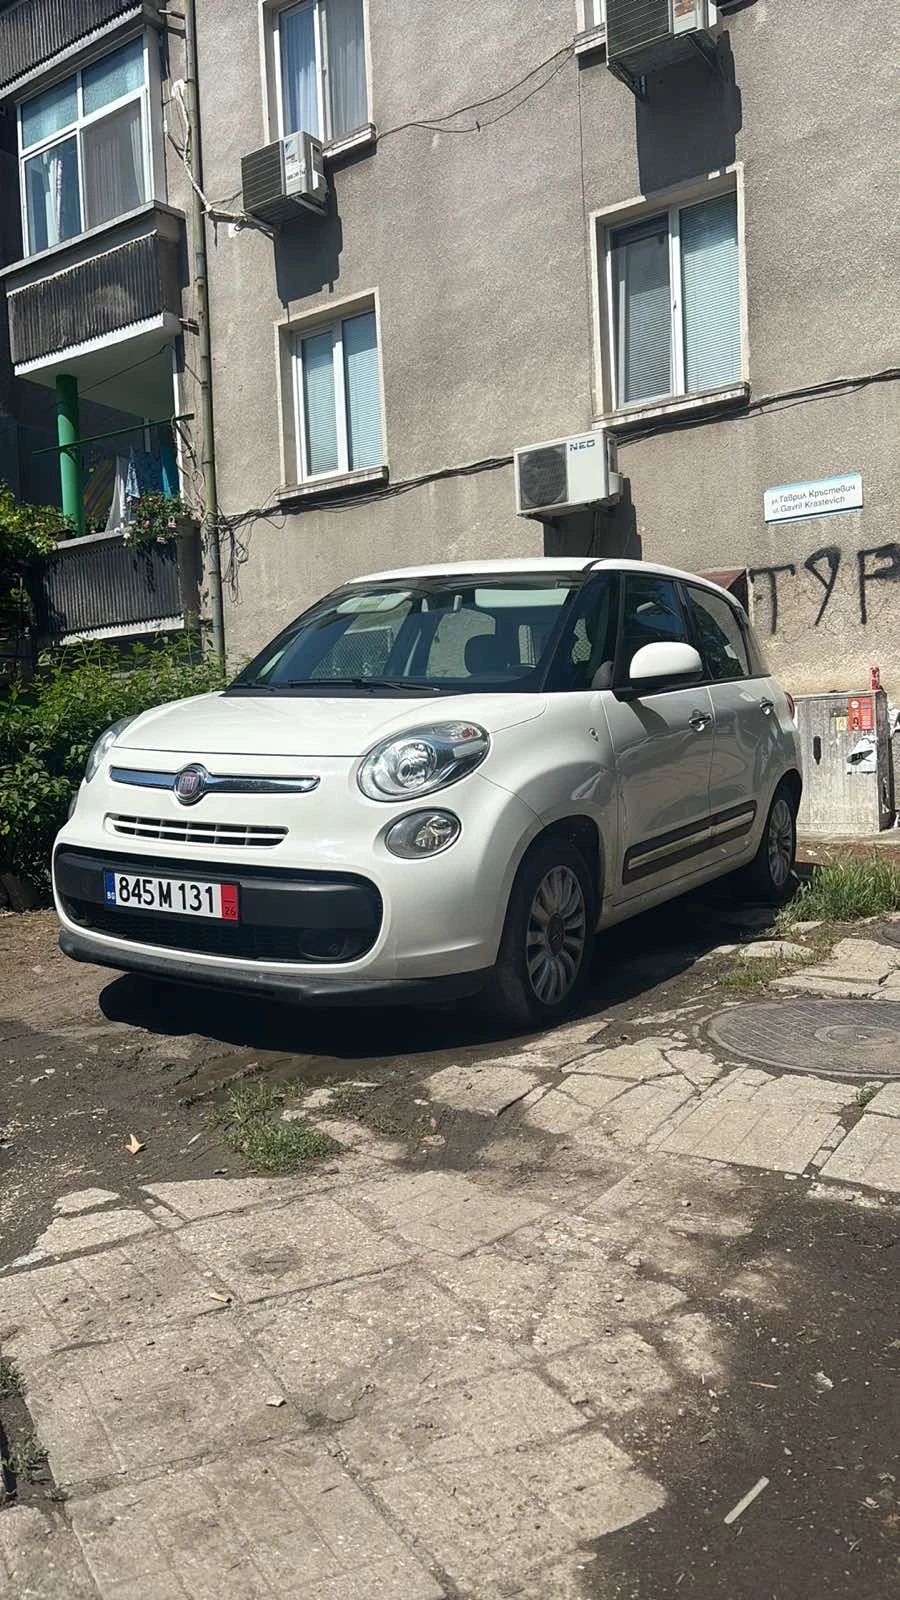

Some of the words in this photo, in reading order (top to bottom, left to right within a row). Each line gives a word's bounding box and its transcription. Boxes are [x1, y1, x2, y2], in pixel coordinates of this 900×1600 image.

[569, 439, 596, 452] NEO
[808, 484, 856, 498] Кръстевич
[780, 502, 803, 513] Gavril
[804, 496, 846, 508] Krastevich
[106, 892, 115, 900] BG
[119, 876, 155, 906] 845
[158, 881, 172, 908] M
[178, 883, 213, 913] 131
